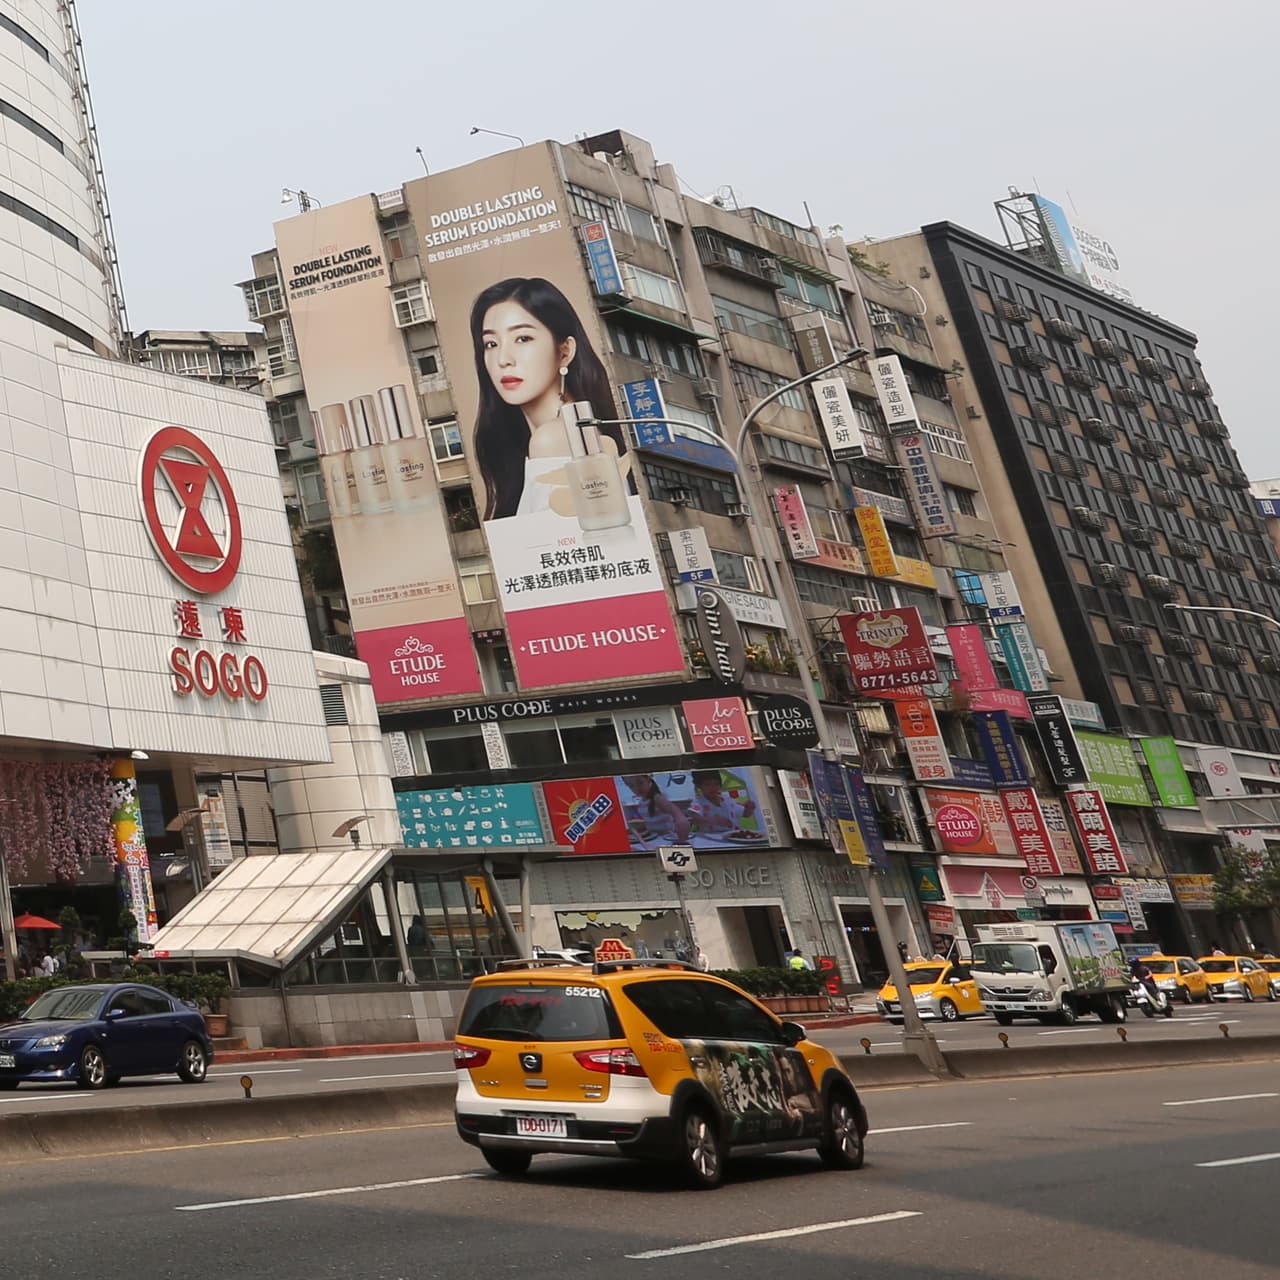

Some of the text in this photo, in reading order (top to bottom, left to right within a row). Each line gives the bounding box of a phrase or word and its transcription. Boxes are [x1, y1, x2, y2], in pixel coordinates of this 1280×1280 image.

[430, 186, 543, 229] DOUBLE LASTING
[425, 200, 558, 249] SERUM FOUNDATION
[293, 245, 372, 276] DOUBLE LASTING
[289, 256, 382, 290] SERUM FOUNDATION
[557, 536, 576, 546] NEW
[539, 545, 605, 569] 長效待肌
[690, 572, 704, 581] 5F
[175, 600, 248, 642] 遠東
[999, 608, 1013, 616] 5F
[527, 624, 657, 656] ETUDE HOUSE
[858, 625, 908, 642] TRINITY
[169, 646, 269, 701] SOGO
[389, 652, 446, 675] ETUDE
[400, 672, 441, 687] HOUSE
[861, 670, 938, 688] 8771-5643
[452, 706, 498, 723] PLUS
[501, 699, 553, 718] CODE
[624, 716, 662, 738] PLUS
[631, 727, 675, 742] CODE
[691, 722, 732, 735] LASH
[771, 717, 815, 731] CODE
[703, 734, 748, 748] CODE
[1168, 795, 1188, 806] 3F
[938, 820, 978, 830] ETUDE
[1005, 791, 1054, 874] 戴爾美語
[1072, 793, 1120, 872] 戴爾美語
[690, 867, 772, 888] SO NICE
[565, 986, 601, 999] 55212
